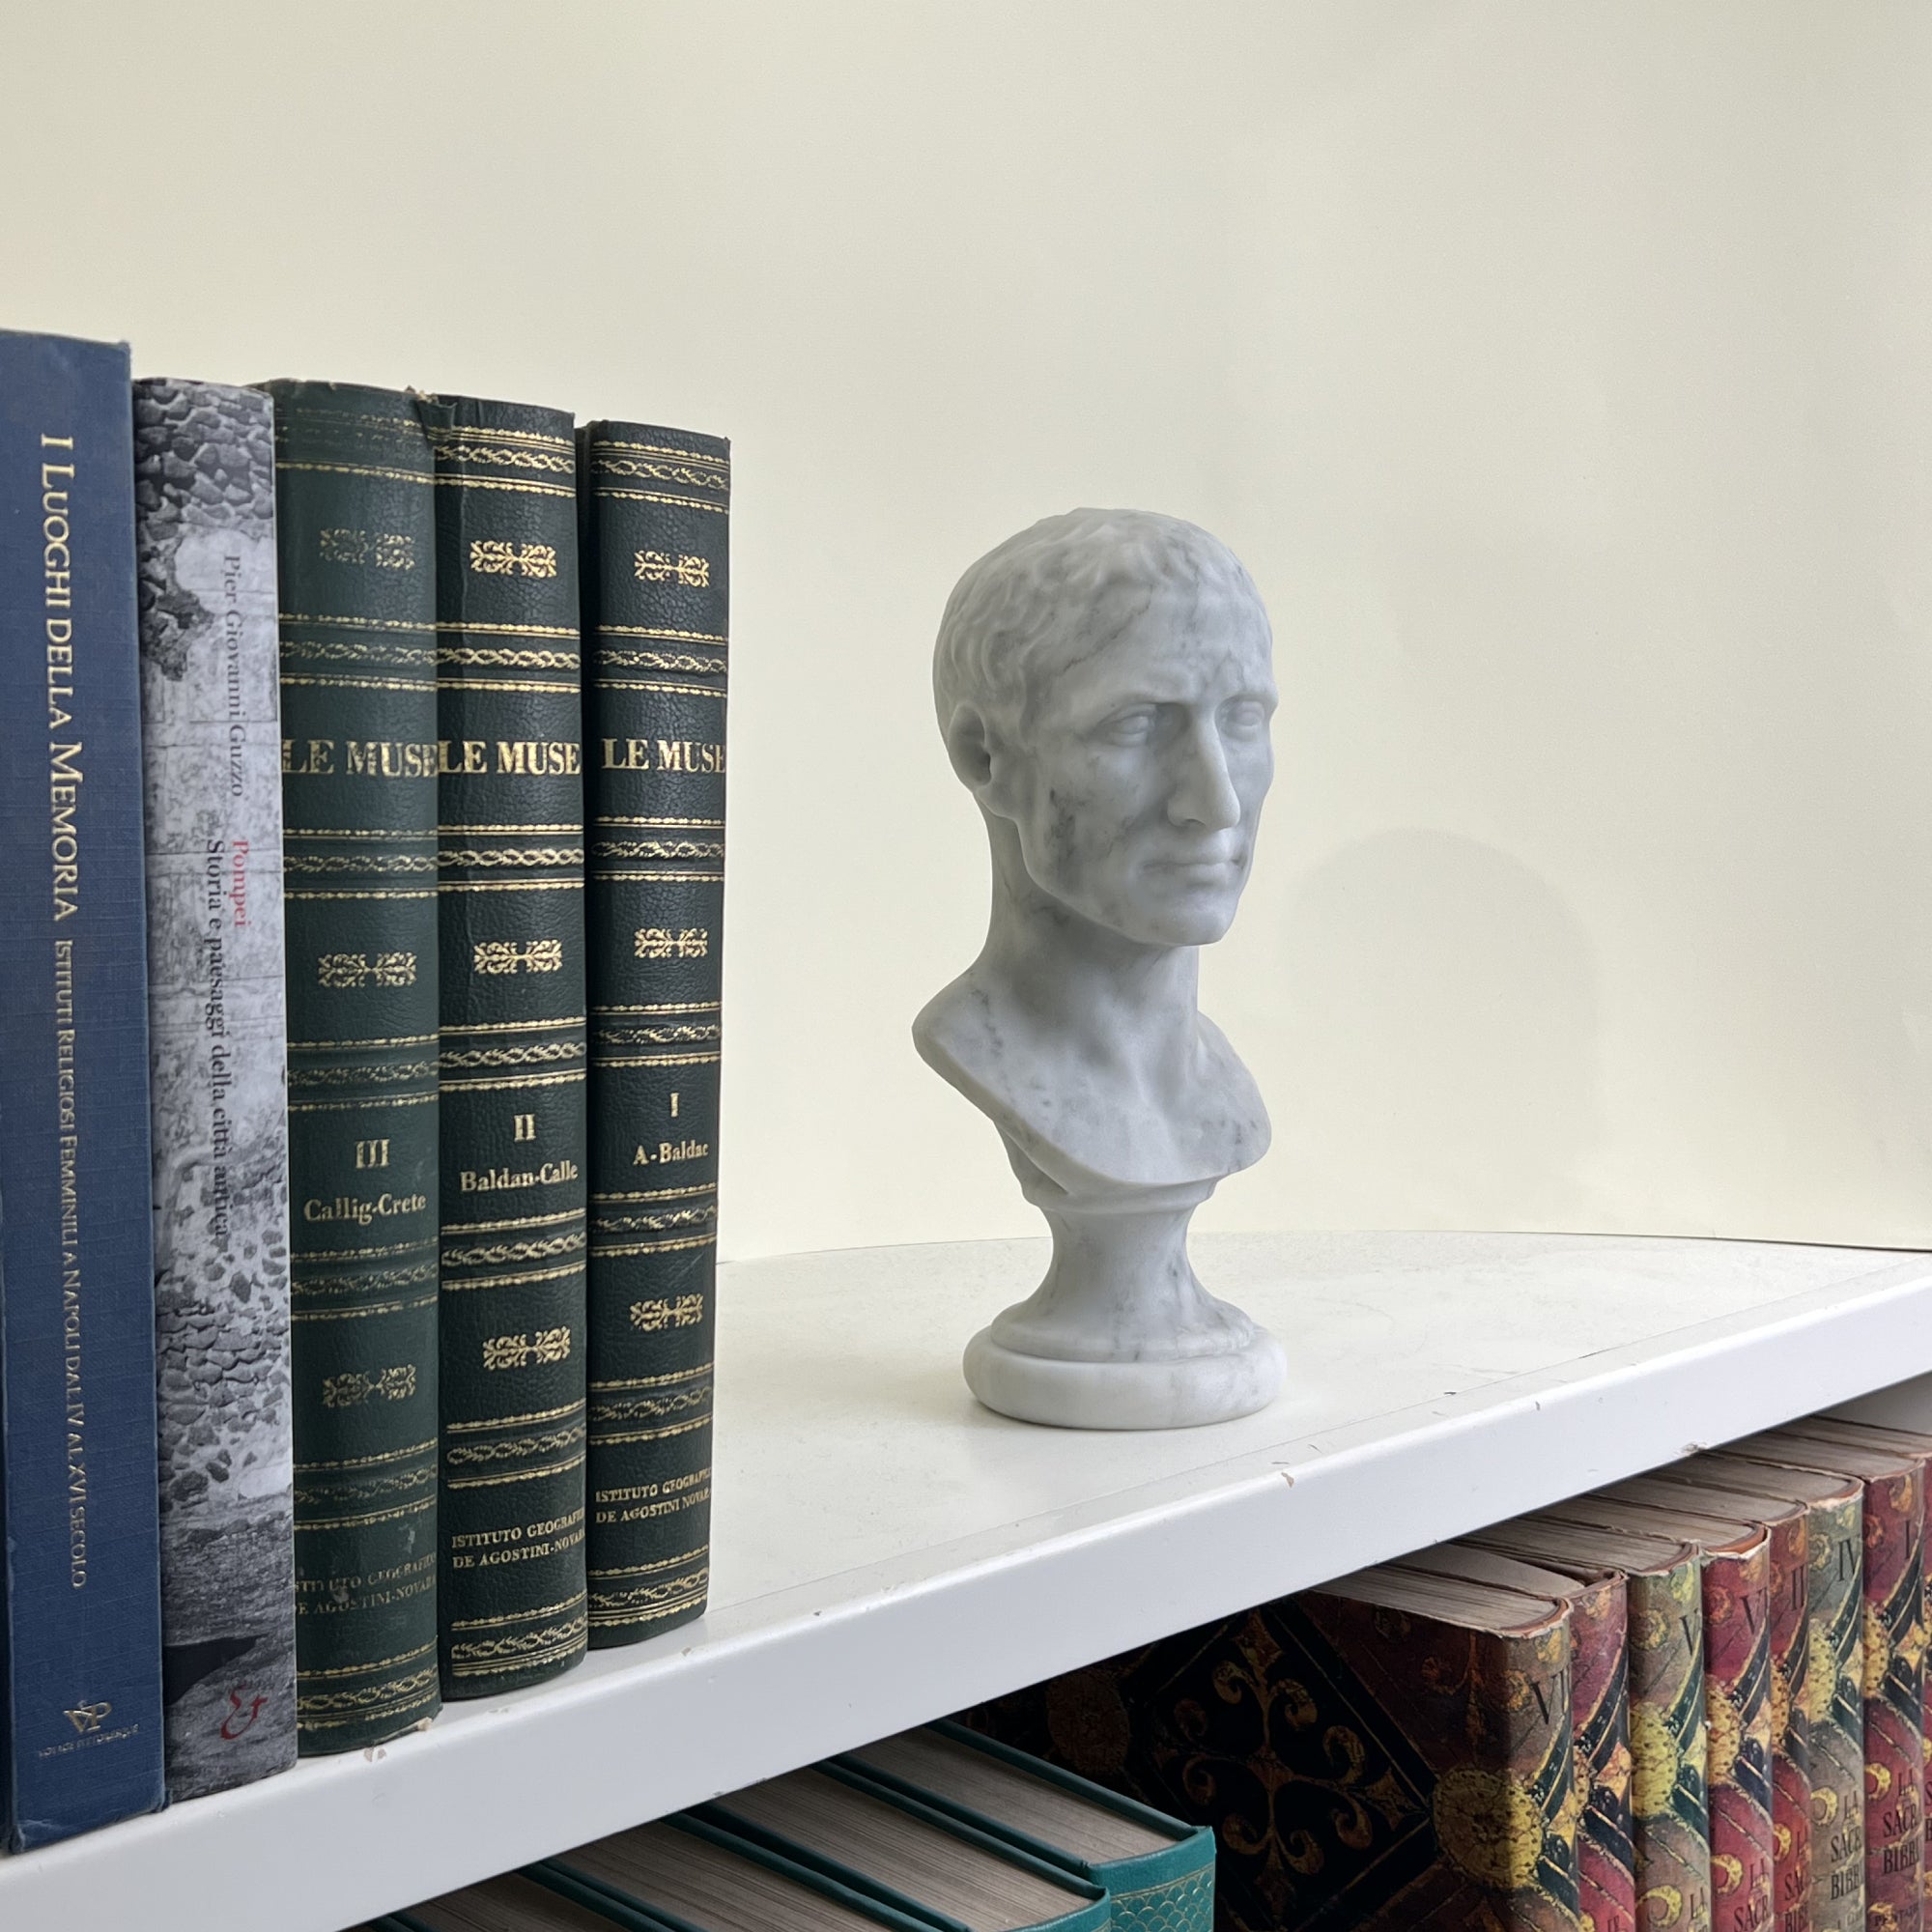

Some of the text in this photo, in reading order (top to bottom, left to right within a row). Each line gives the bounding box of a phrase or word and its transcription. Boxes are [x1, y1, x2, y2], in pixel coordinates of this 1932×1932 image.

[42, 433, 73, 449] I
[41, 464, 74, 608] LUOGHI
[45, 618, 73, 729] DELLA
[223, 555, 247, 798] Pier Giovanni Guzzo
[281, 739, 334, 774] LE
[438, 740, 581, 776] LE MUSE
[601, 738, 726, 773] LE MUSE
[48, 742, 84, 923] MEMORIA
[228, 839, 251, 928] Pompei
[53, 940, 74, 1025] ISTITUTI
[204, 838, 234, 1238] Storia e paesaggi della città antica
[56, 1030, 77, 1131] RELIGIOSI
[669, 1092, 680, 1118] I
[513, 1113, 537, 1143] II
[355, 1138, 391, 1169] III
[59, 1136, 79, 1246] FEMMINILI
[460, 1160, 579, 1193] Baldan-Calle
[62, 1270, 81, 1350] NAPOLI
[65, 1356, 83, 1401] DAL
[66, 1403, 85, 1428] IV
[67, 1433, 85, 1462] AL
[69, 1463, 88, 1504] XVI
[595, 1483, 659, 1503] ISTITUTO
[595, 1510, 617, 1524] DE
[70, 1506, 88, 1589] SECOLO
[451, 1526, 523, 1548] ISTITUTO
[452, 1554, 475, 1569] DE
[1884, 1804, 1918, 1838] SACR
